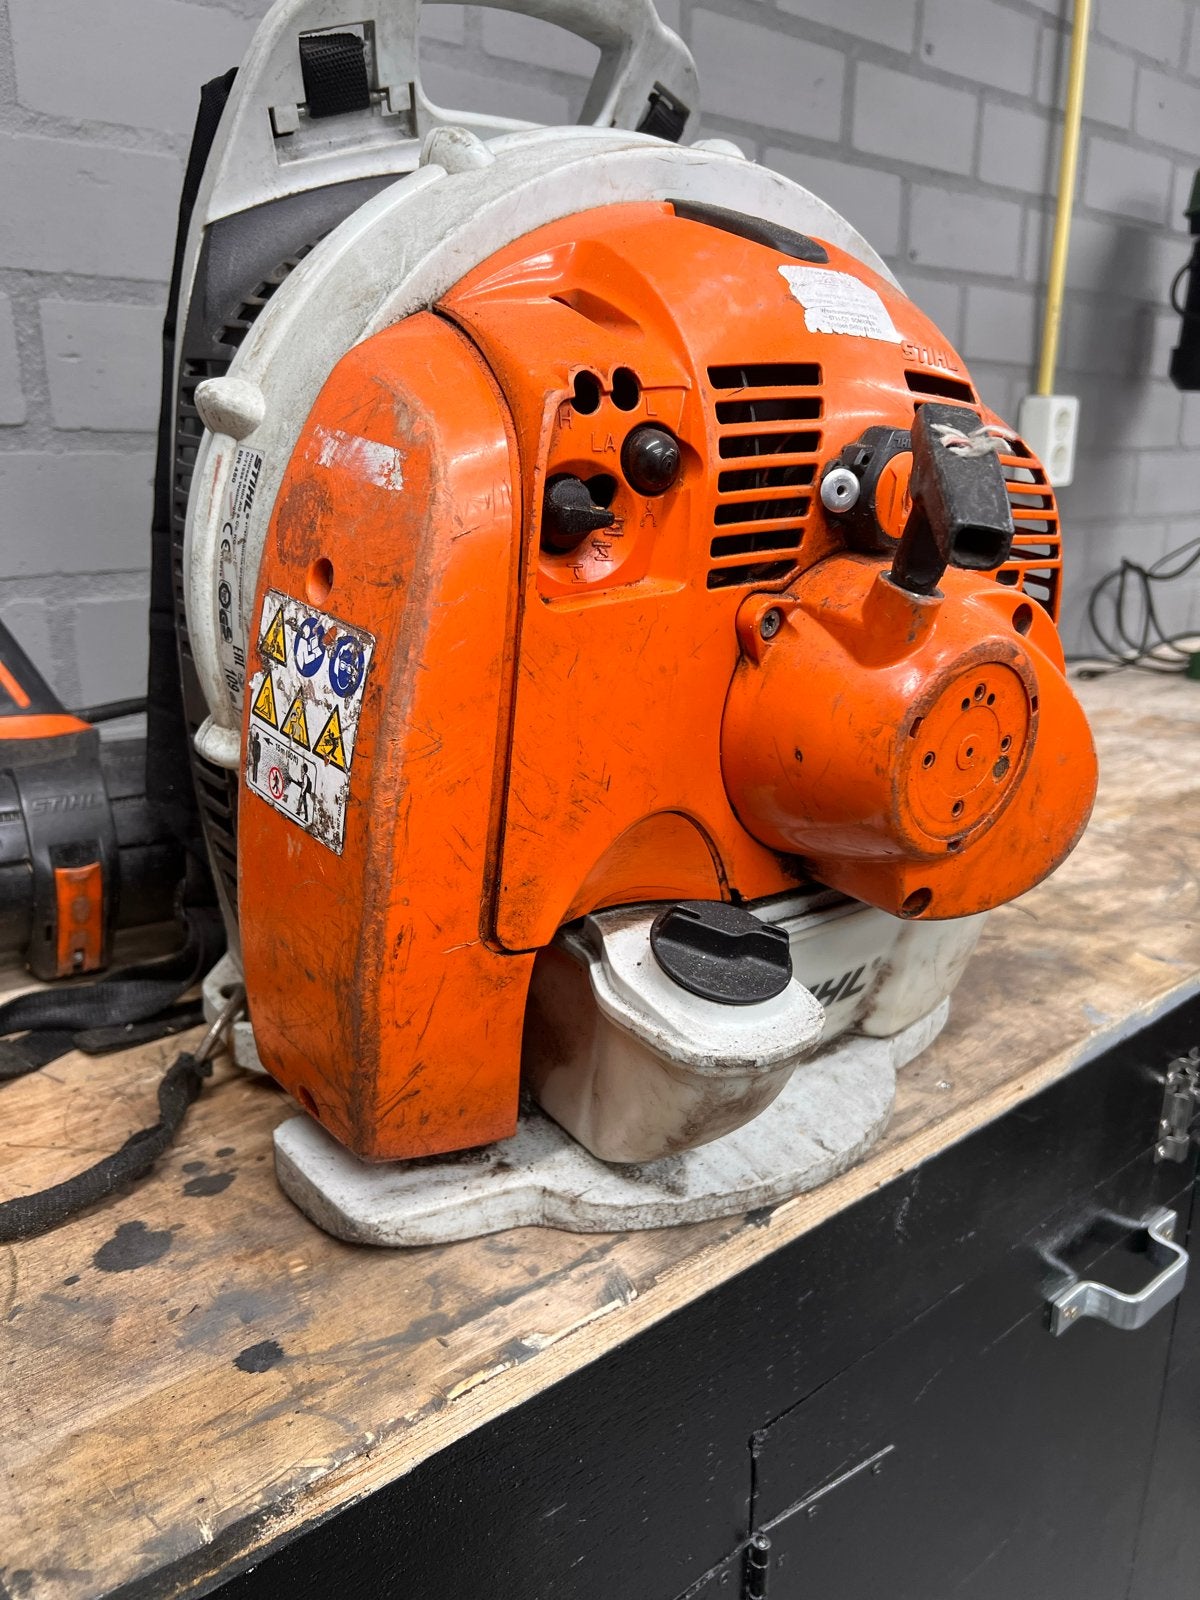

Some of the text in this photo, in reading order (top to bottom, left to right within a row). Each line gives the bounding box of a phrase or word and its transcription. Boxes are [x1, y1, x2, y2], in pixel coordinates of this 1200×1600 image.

[901, 341, 959, 371] STIHL
[645, 396, 657, 417] L
[558, 408, 572, 430] H
[591, 431, 616, 453] LA
[244, 452, 254, 482] Andreas
[243, 453, 263, 513] STIHL
[224, 668, 240, 693] 109
[32, 792, 99, 815] STIHL
